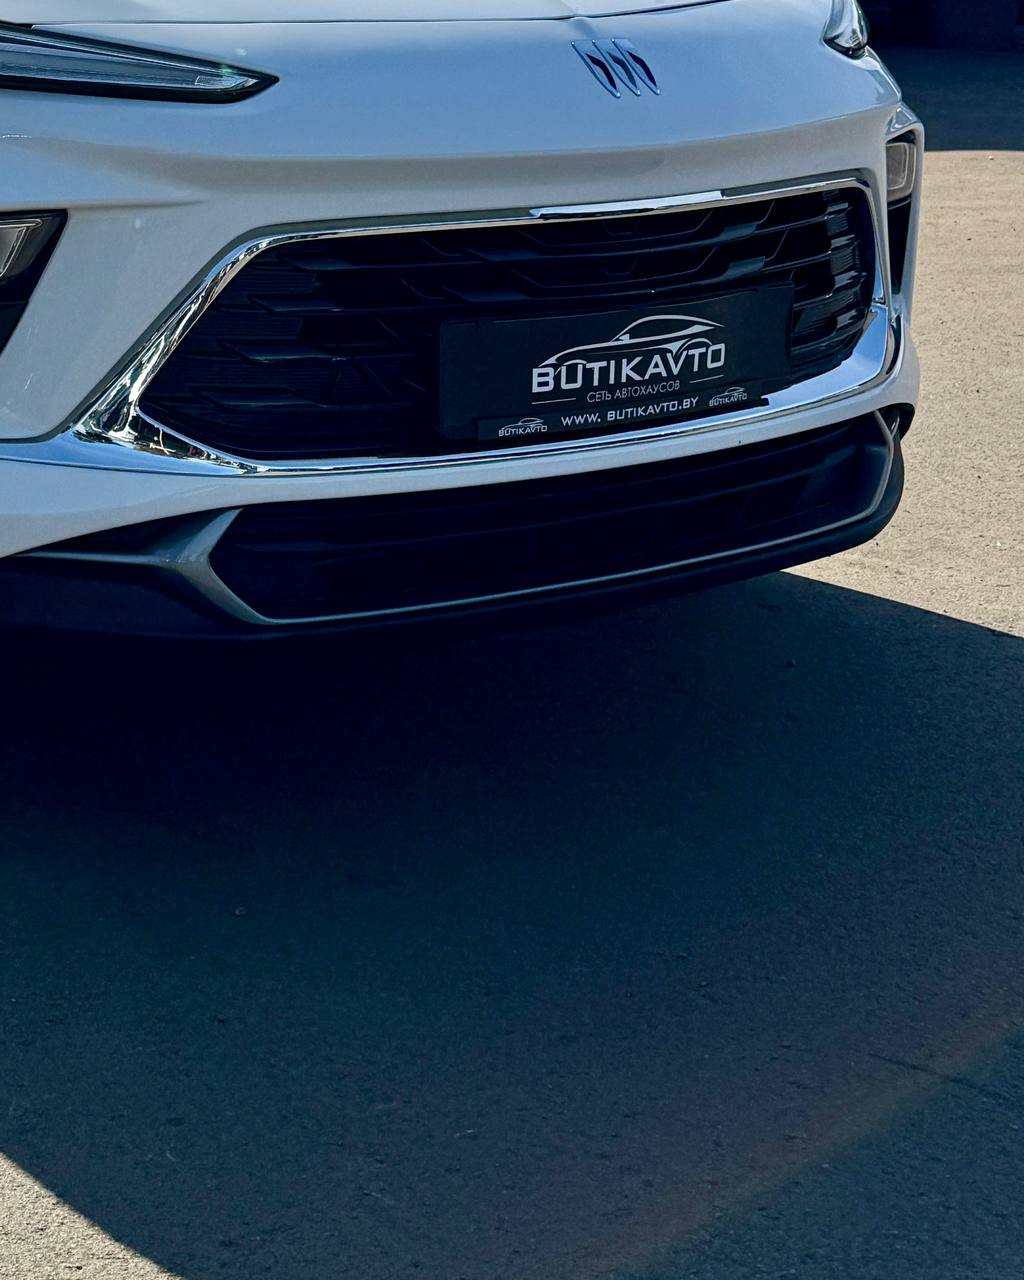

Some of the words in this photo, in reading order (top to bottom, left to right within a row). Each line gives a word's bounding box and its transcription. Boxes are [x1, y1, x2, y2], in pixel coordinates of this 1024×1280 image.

[531, 343, 725, 393] BUTIKAVTO
[586, 391, 613, 403] СЕТЬ
[614, 380, 681, 400] АВТОХАУСОВ
[709, 393, 748, 407] BUTIKAVTO
[561, 413, 601, 427] WWW.
[607, 396, 700, 421] BUTIKAVTO.BY
[498, 424, 548, 437] BUTIKAVTO
